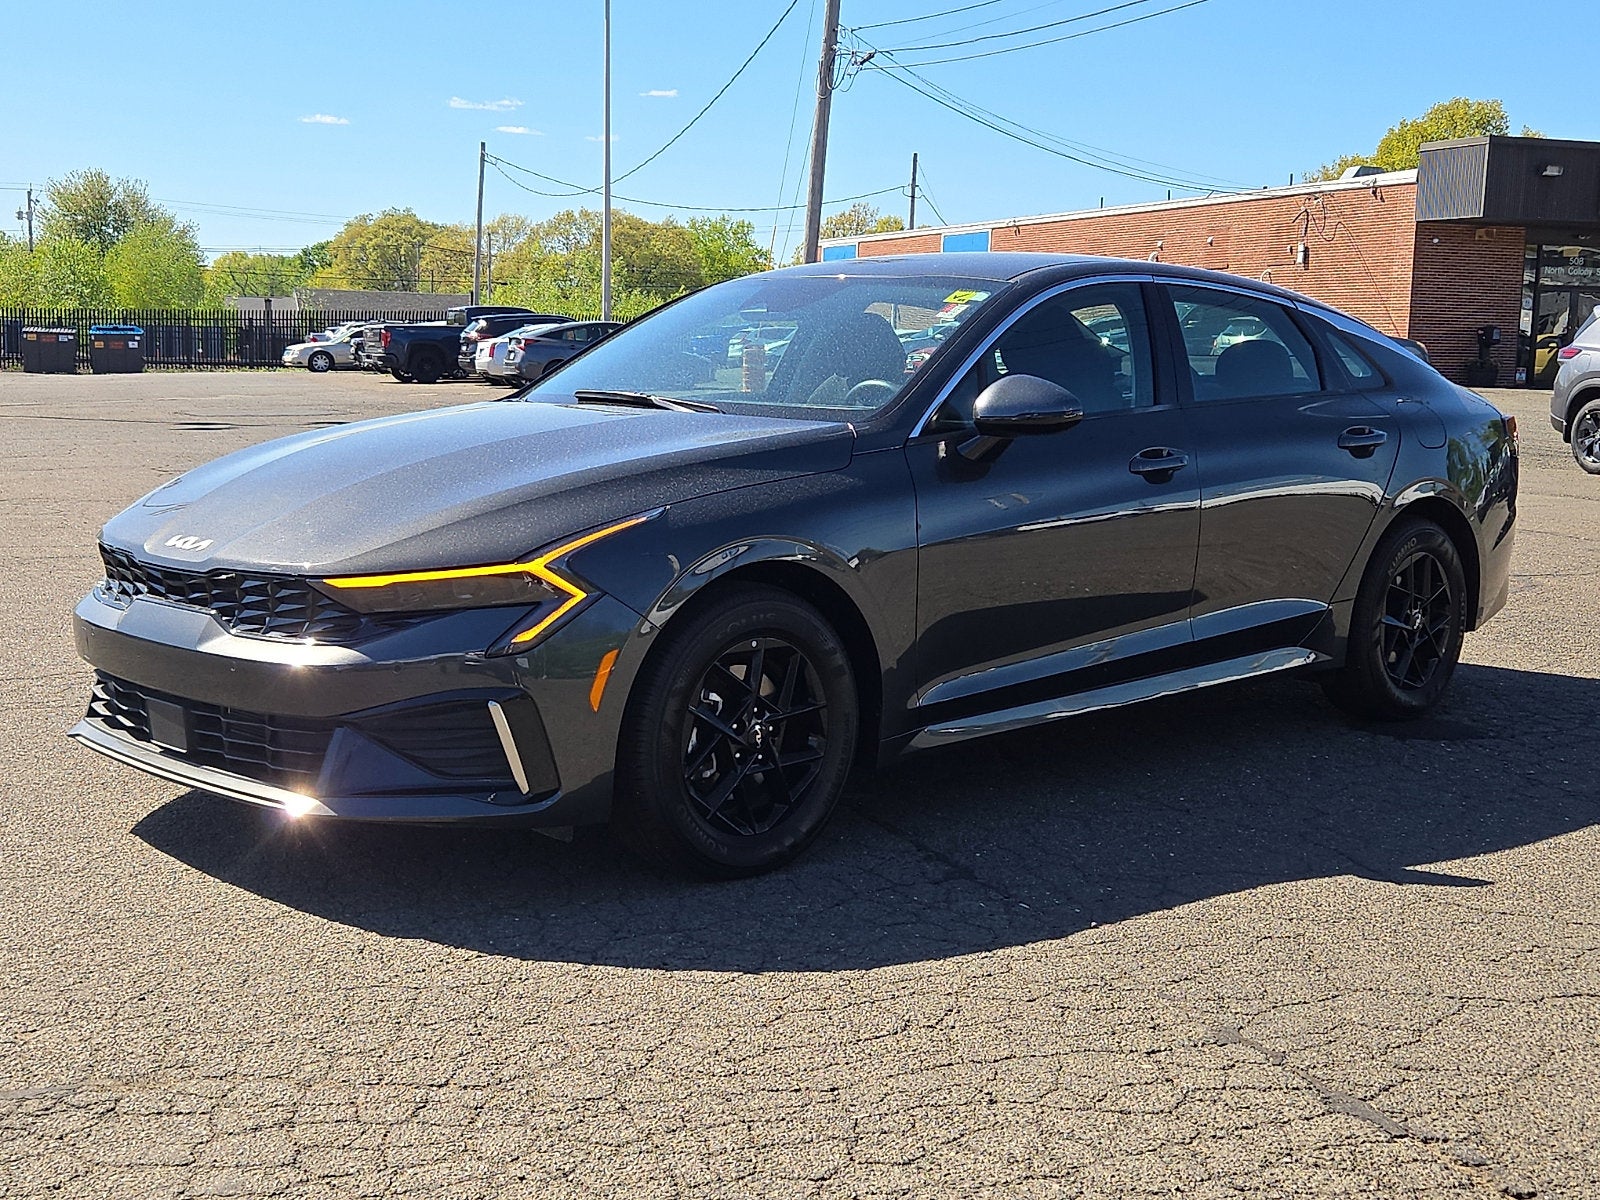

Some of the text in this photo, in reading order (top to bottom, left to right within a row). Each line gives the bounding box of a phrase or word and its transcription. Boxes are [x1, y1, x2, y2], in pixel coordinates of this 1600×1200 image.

[1569, 256, 1585, 266] 508
[1544, 266, 1565, 275] North
[164, 534, 214, 552] KIA
[1387, 537, 1417, 577] KUMHO
